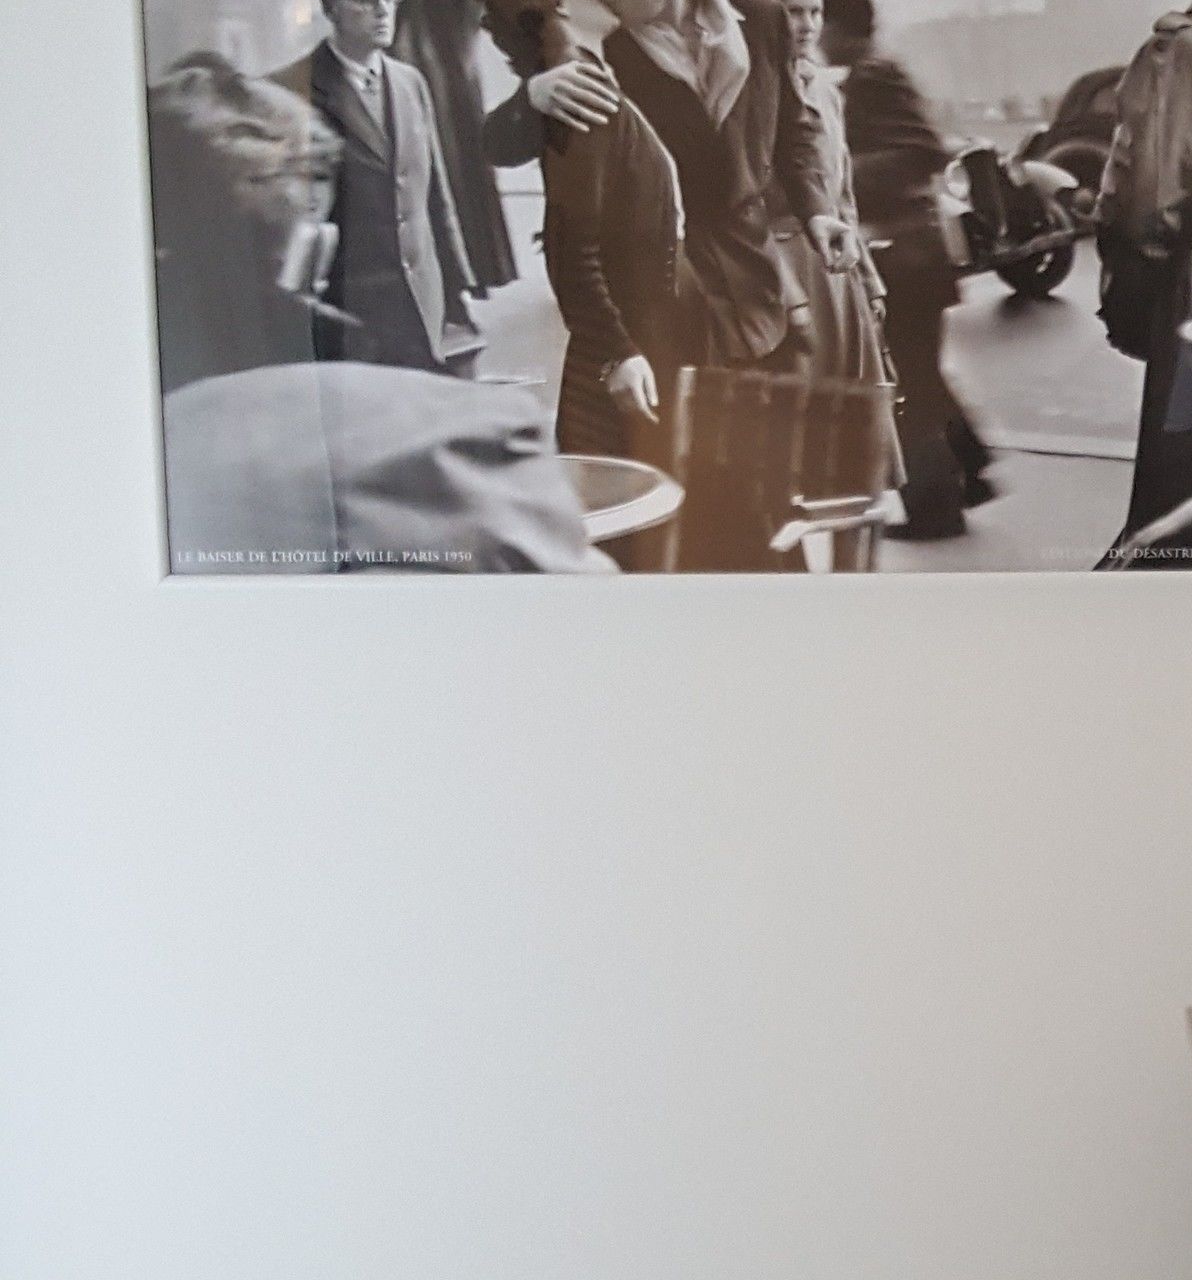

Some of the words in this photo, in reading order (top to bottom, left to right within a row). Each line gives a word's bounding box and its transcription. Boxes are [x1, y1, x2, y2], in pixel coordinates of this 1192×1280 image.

[177, 551, 194, 563] LE
[198, 551, 244, 563] BAISER
[249, 551, 267, 563] DE
[333, 551, 351, 563] DE
[402, 551, 439, 563] PARIS
[445, 551, 472, 563] 1950
